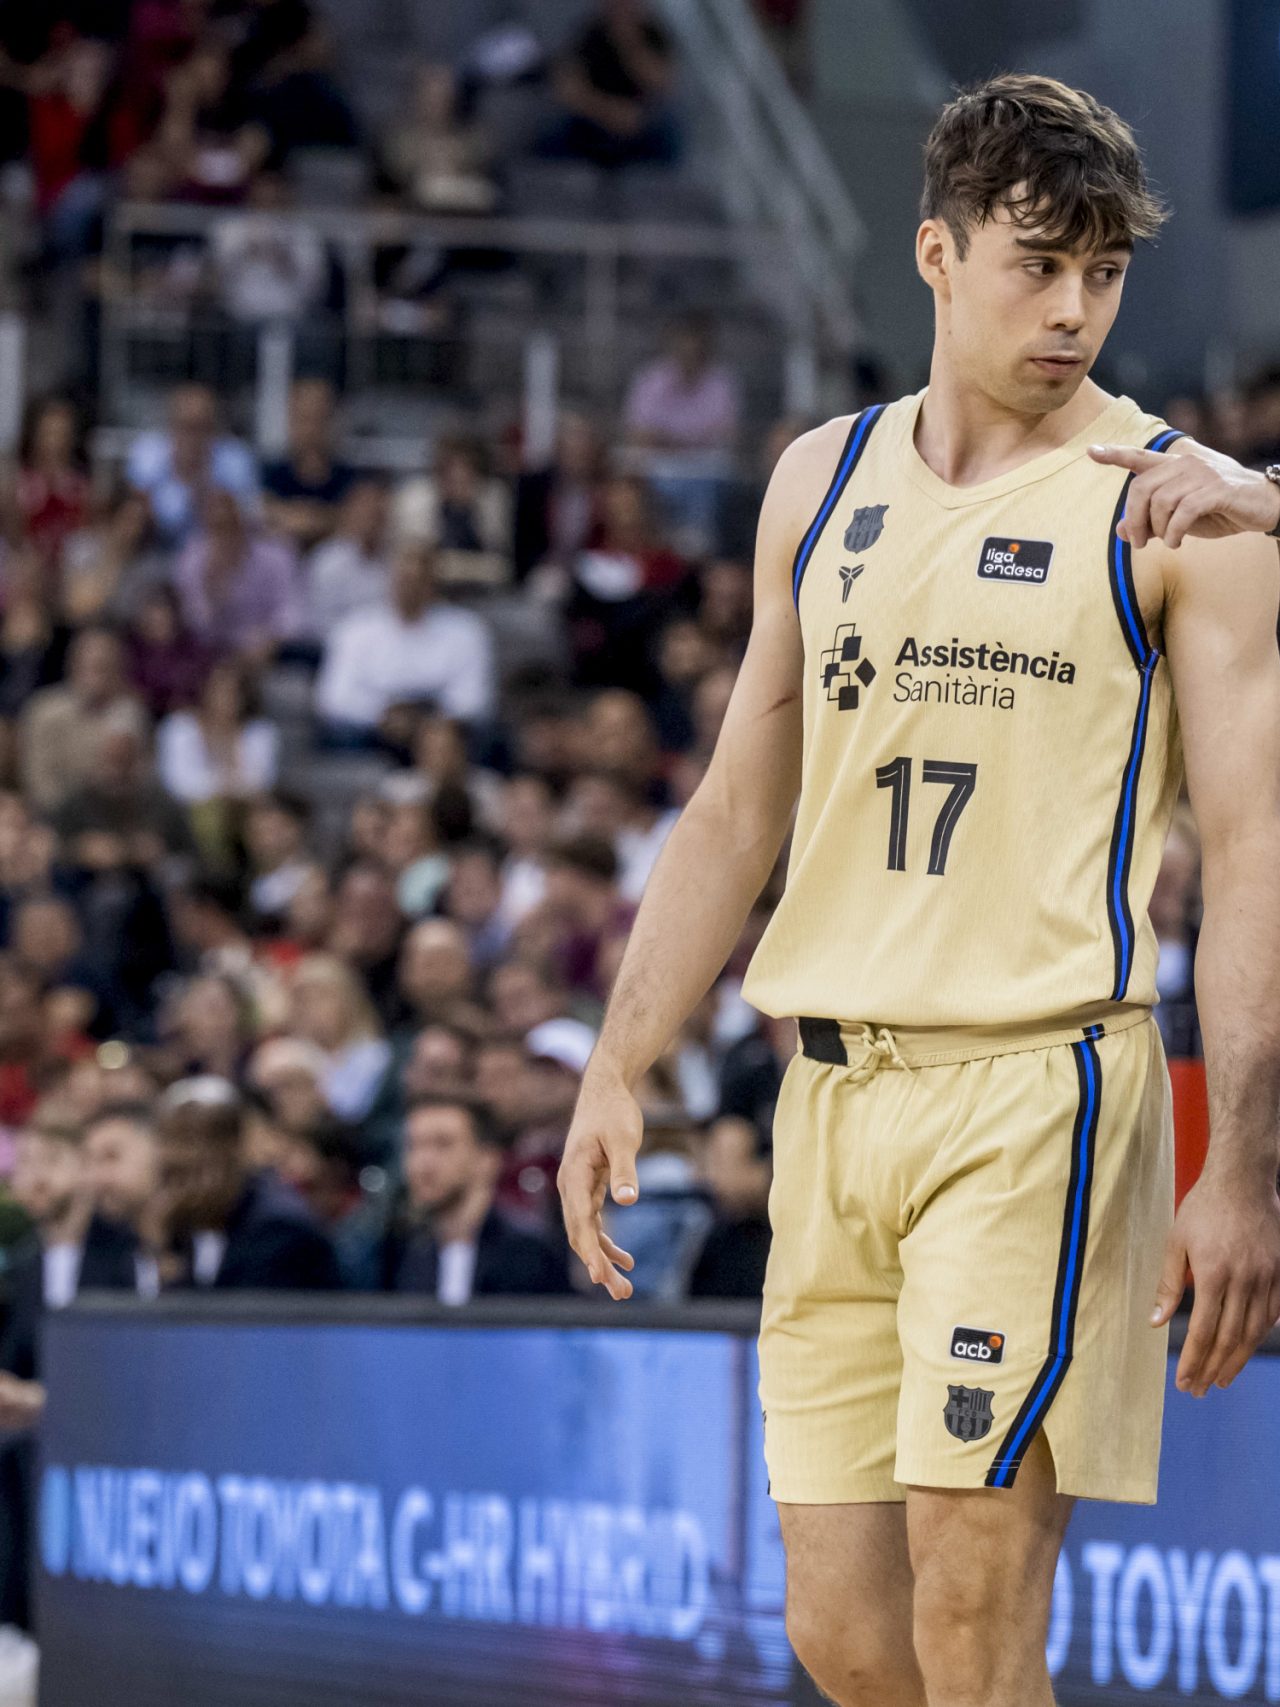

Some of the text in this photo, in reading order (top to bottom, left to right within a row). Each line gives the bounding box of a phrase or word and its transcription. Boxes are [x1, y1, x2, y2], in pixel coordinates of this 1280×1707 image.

[985, 547, 1015, 563] liga
[983, 563, 1045, 579] endesa
[894, 637, 1076, 685] Assistència
[892, 672, 1016, 710] Sanitària
[875, 756, 978, 876] 17
[954, 1341, 991, 1359] acb
